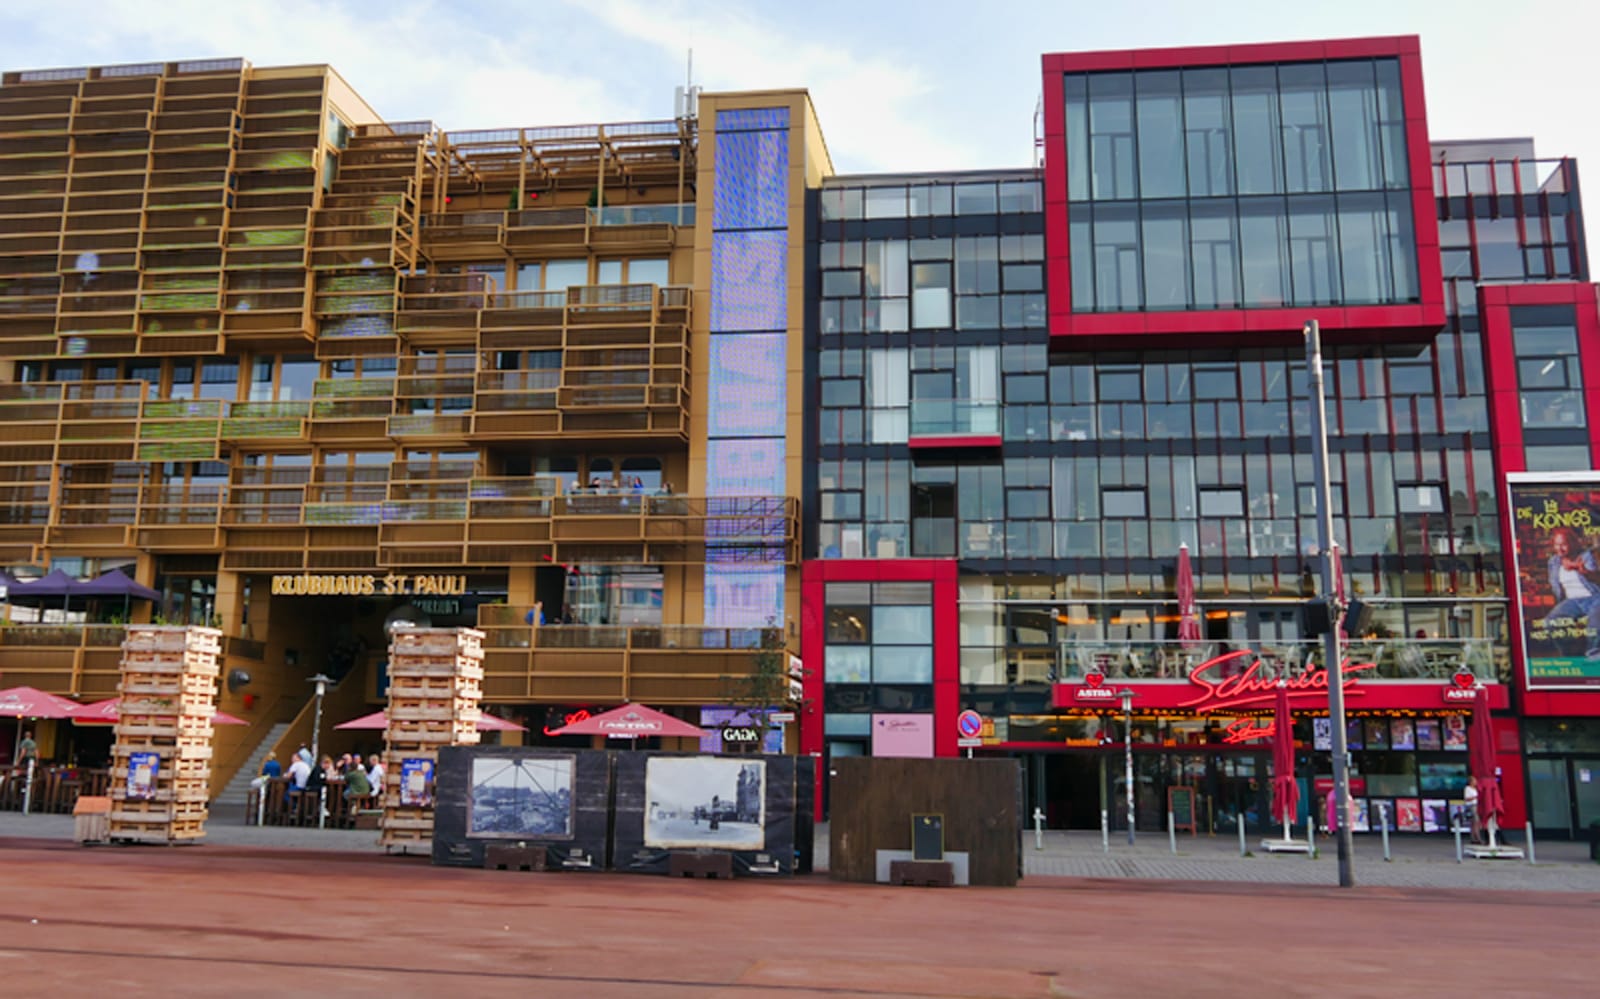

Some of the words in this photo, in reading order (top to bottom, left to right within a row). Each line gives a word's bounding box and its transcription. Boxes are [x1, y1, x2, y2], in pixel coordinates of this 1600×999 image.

[271, 575, 375, 596] KLUBHAUS
[383, 574, 410, 595] ST.
[414, 575, 467, 596] PAULI
[1077, 688, 1114, 698] ASTRA
[1447, 689, 1477, 699] ASTR
